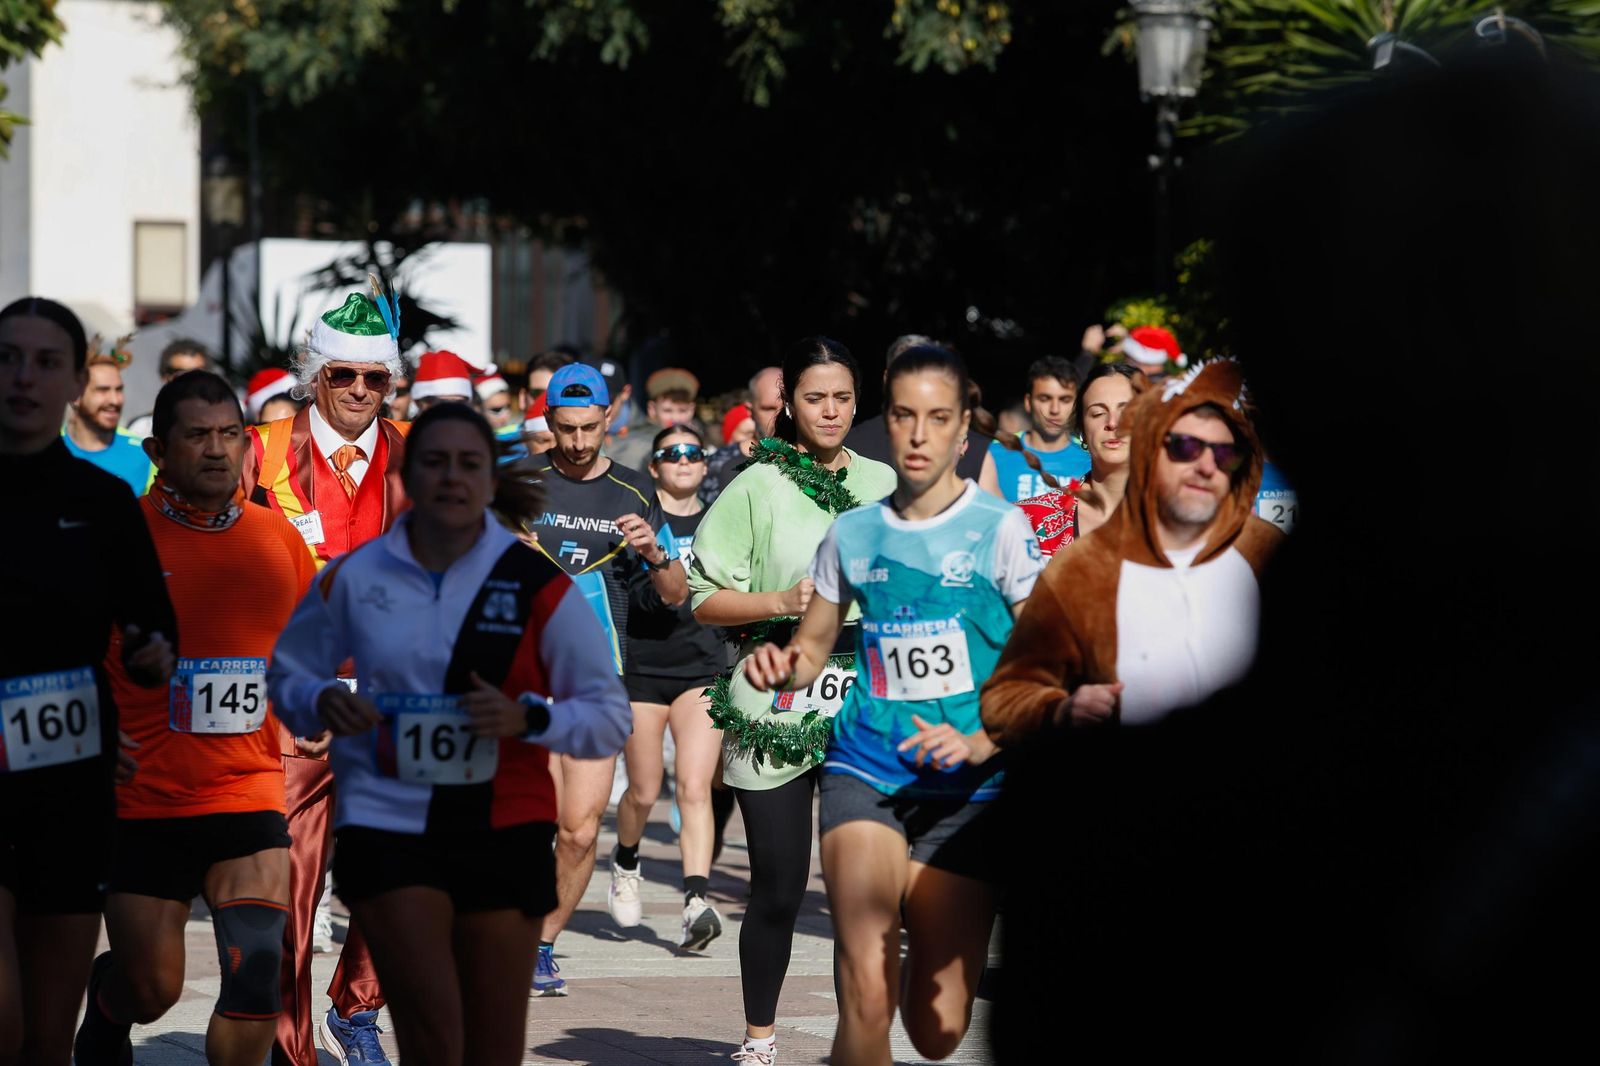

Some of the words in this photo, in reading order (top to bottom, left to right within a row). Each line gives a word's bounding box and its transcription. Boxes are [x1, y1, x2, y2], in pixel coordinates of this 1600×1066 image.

[882, 618, 959, 633] CARRERA
[200, 660, 265, 670] CARRERA
[888, 645, 954, 679] 163
[198, 682, 259, 714] 145
[806, 673, 857, 702] 166
[11, 699, 87, 746] 160
[405, 723, 479, 762] 167
